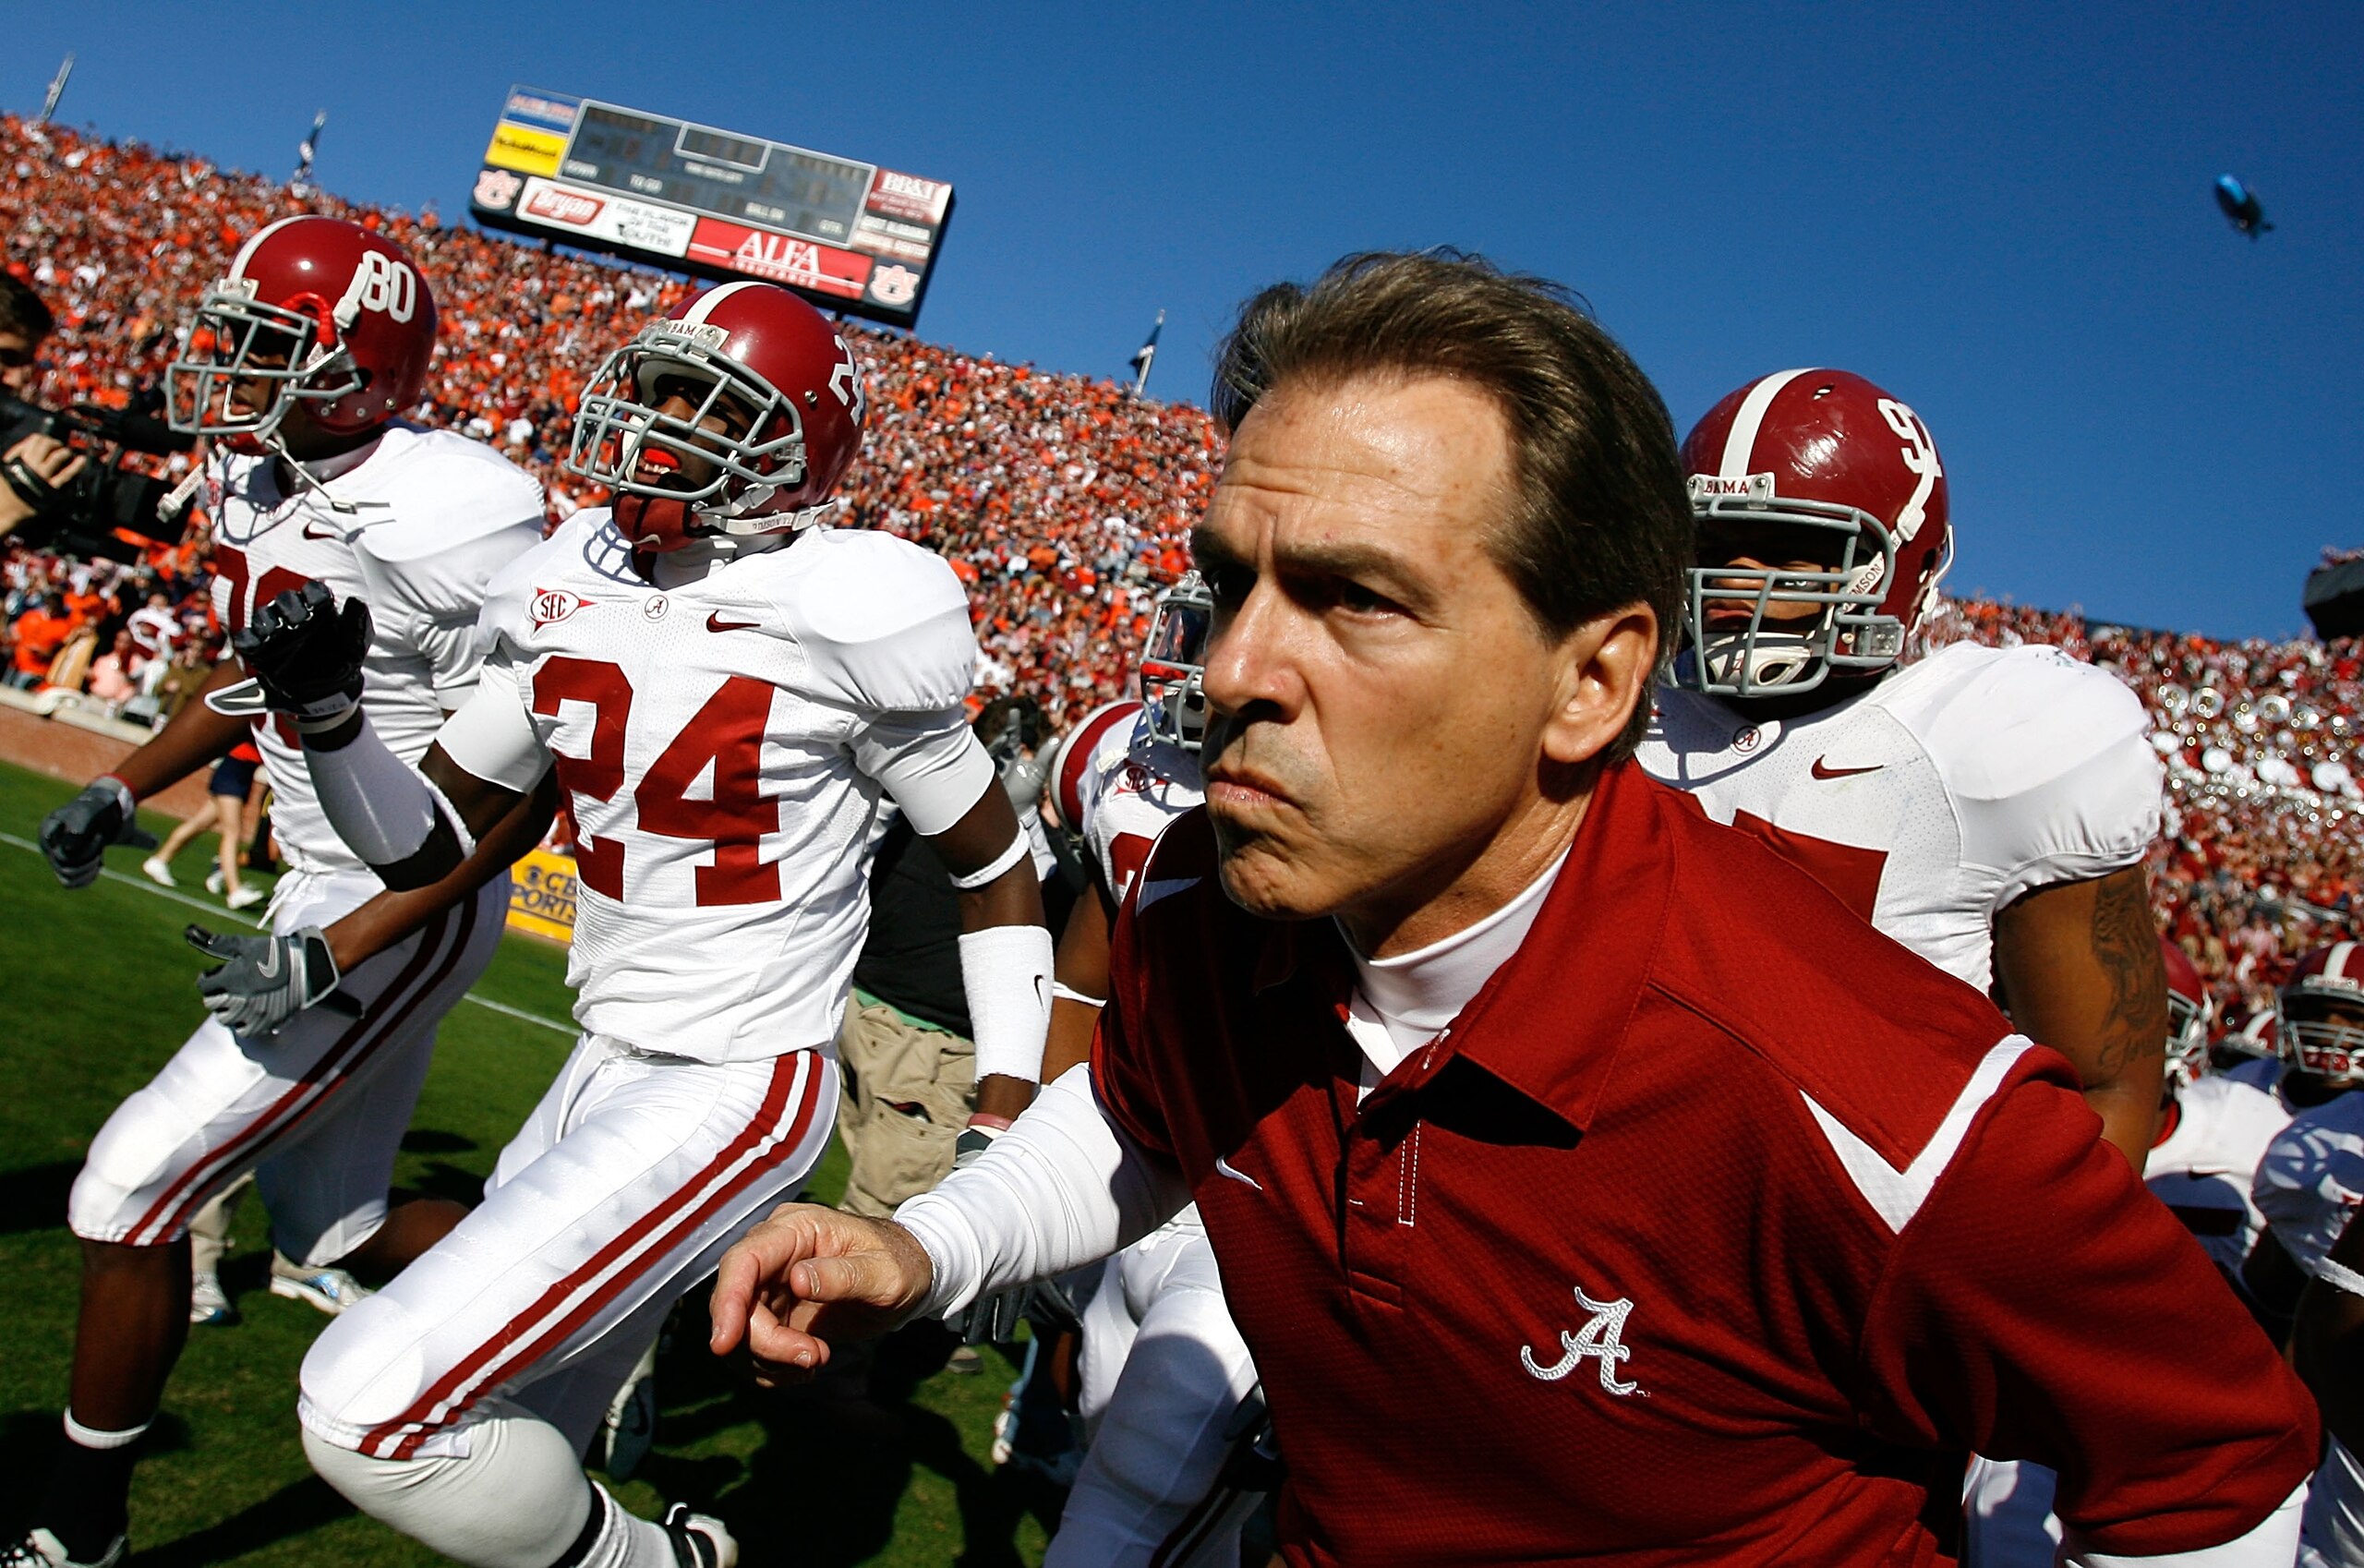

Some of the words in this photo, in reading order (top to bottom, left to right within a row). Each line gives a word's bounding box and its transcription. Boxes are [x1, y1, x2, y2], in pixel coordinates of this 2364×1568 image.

[736, 232, 821, 274] ALFA
[361, 249, 416, 325] 80
[1704, 480, 1748, 494] BAMA
[540, 594, 567, 620] SEC
[532, 655, 782, 907] 24
[547, 873, 577, 897] CB
[1521, 1286, 1636, 1395] A
